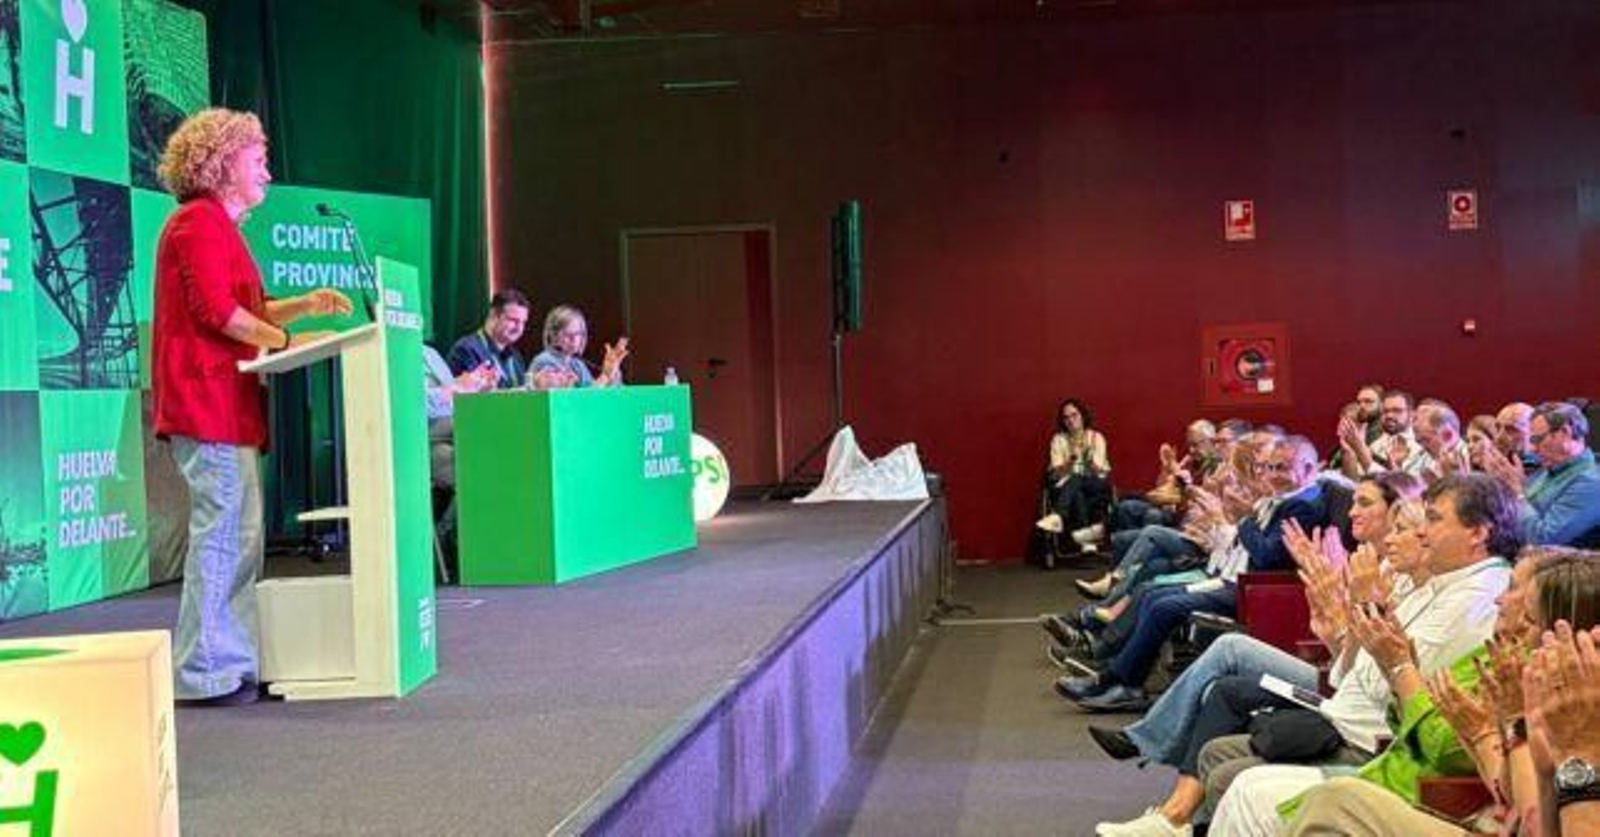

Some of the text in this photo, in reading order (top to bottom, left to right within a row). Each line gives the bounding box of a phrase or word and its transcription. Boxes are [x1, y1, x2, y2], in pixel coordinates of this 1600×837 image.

[55, 38, 95, 134] H
[58, 449, 118, 482] HUELVA
[59, 484, 96, 515] POR
